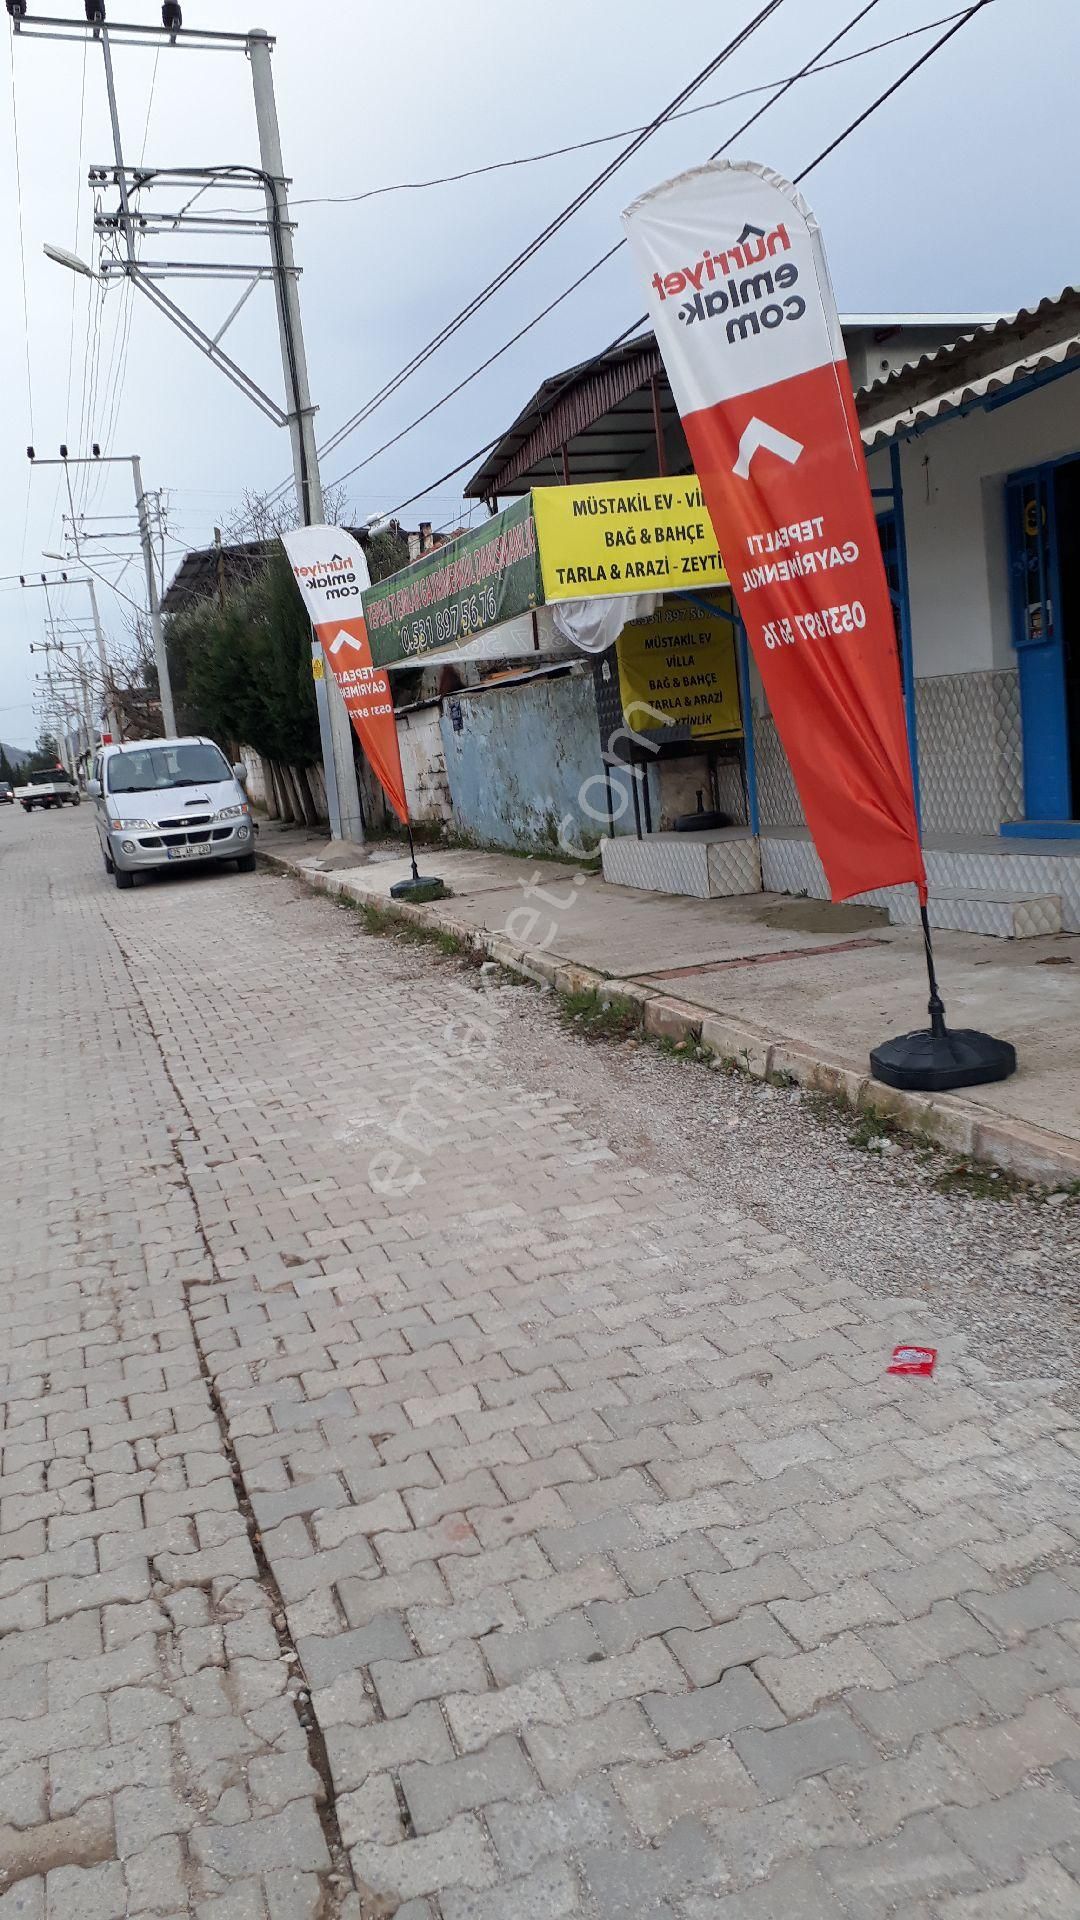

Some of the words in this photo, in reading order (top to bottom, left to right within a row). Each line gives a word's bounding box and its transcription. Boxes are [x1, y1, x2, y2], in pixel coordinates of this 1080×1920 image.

[573, 493, 651, 517] MÜSTAKİL
[655, 493, 673, 510] EV
[605, 526, 636, 547] BAĞ
[640, 531, 651, 545] &
[655, 524, 705, 545] BAHÇE
[556, 565, 607, 585] TARLA
[610, 564, 621, 580] &
[625, 556, 670, 578] ARAZİ
[436, 604, 458, 640] 897
[461, 594, 479, 630] 56
[479, 587, 496, 622] 76
[644, 634, 697, 649] MÜSTAKİL
[699, 633, 712, 643] EV
[666, 654, 695, 668] VİLLA
[648, 677, 671, 690] BAĞ
[673, 678, 681, 687] &
[683, 673, 717, 687] BAHÇE
[648, 697, 681, 710] TARLA
[684, 696, 692, 706] &
[694, 691, 723, 705] ARAZİ
